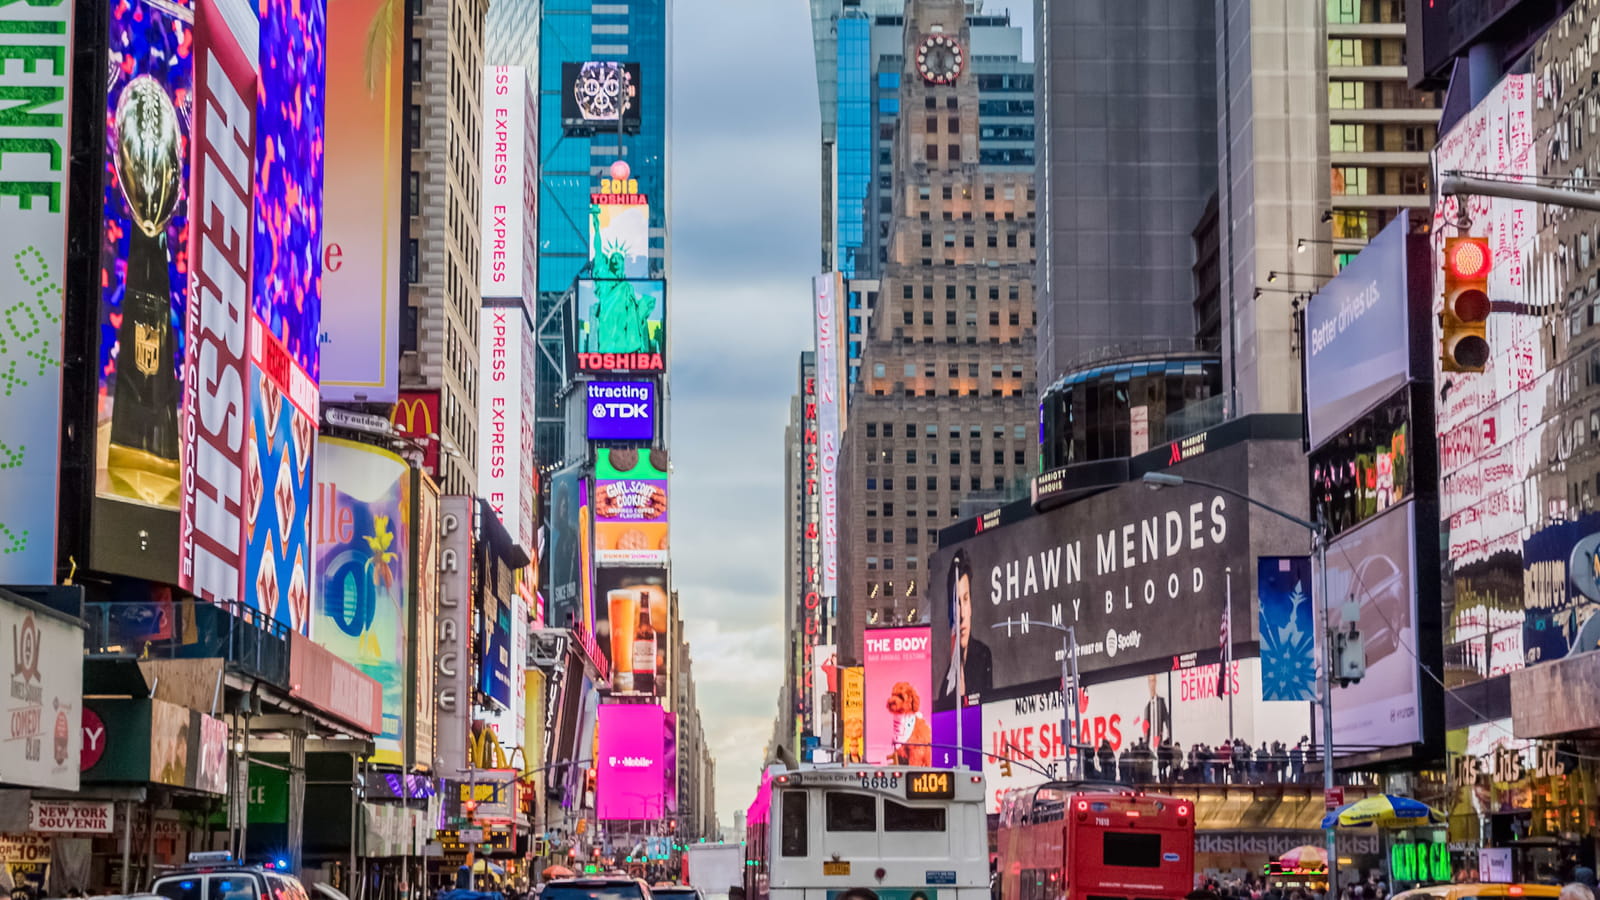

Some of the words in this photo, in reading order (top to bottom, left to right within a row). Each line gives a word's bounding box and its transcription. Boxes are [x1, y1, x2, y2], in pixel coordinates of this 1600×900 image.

[494, 108, 508, 185] EXPRESS
[601, 179, 638, 194] 2018
[591, 194, 648, 205] TOSHIBA
[493, 205, 506, 283] EXPRESS
[190, 270, 199, 359] MILK
[1312, 316, 1337, 356] Better
[1338, 292, 1365, 334] drives
[819, 276, 833, 404] JUSTIN
[577, 353, 663, 370] TOSHIBA
[588, 385, 648, 400] ttracting
[605, 403, 648, 418] TDK
[351, 415, 384, 427] outdoor
[491, 397, 505, 478] EXPRESS
[804, 378, 817, 494] ERNST
[1182, 432, 1207, 448] MARRIOTT
[1182, 445, 1205, 459] MARQUIS
[183, 363, 197, 577] CHOCOLATE
[1038, 470, 1066, 484] MARRIOTT
[606, 481, 630, 498] GIRL
[630, 480, 657, 498] SCOUT
[1038, 483, 1063, 496] MARQUIS
[616, 494, 646, 508] COOKIE
[804, 523, 817, 539] &
[991, 541, 1081, 606] SHAWN
[1097, 496, 1227, 576] MENDES
[1008, 611, 1030, 638] IN
[1052, 598, 1080, 628] MY
[1106, 567, 1203, 614] BLOOD
[439, 514, 458, 712] PALACE
[866, 638, 891, 652] THE
[893, 637, 929, 651] BODY
[1118, 630, 1142, 651] Spotify
[1015, 694, 1036, 716] NOW
[10, 708, 42, 738] COMEDY
[25, 737, 41, 762] CLUB
[834, 774, 848, 783] City
[1046, 762, 1059, 780] OF
[861, 777, 898, 790] 6688
[39, 807, 70, 819] NEW
[73, 807, 108, 819] YORK
[39, 819, 107, 830] SOUVENIR
